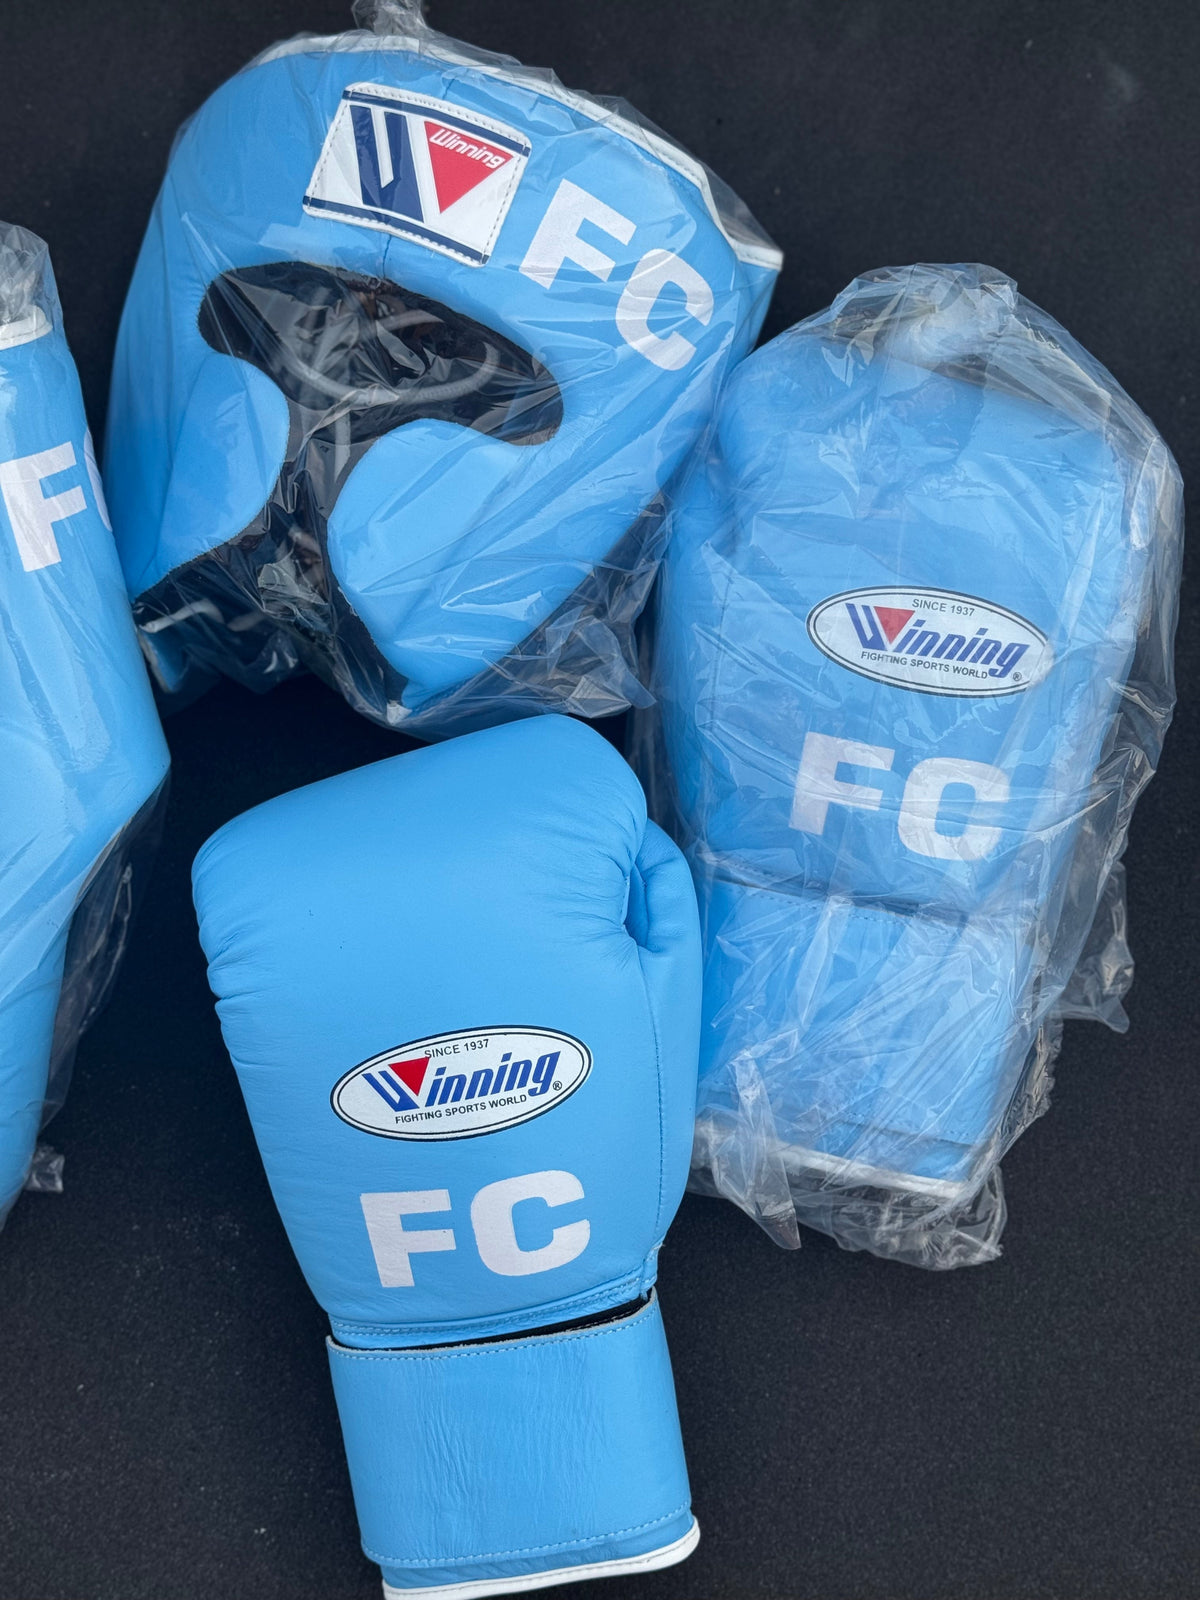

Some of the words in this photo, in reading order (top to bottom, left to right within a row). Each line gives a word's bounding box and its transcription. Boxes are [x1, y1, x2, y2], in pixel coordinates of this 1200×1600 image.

[429, 129, 505, 170] Winning
[518, 178, 715, 371] FC
[911, 598, 947, 613] SINCE
[950, 604, 976, 617] 1937
[845, 603, 1031, 679] Winning
[861, 651, 908, 666] FIGHTING
[910, 658, 950, 673] SPORTS
[952, 665, 988, 680] WORLD
[788, 731, 1010, 861] FC
[424, 1044, 461, 1058] SINCE
[464, 1038, 490, 1052] 1937
[361, 1051, 561, 1112] Winning
[395, 1109, 443, 1124] FIGHTING
[445, 1102, 487, 1117] SPORTS
[489, 1094, 527, 1109] WORLD
[360, 1170, 591, 1288] FC
